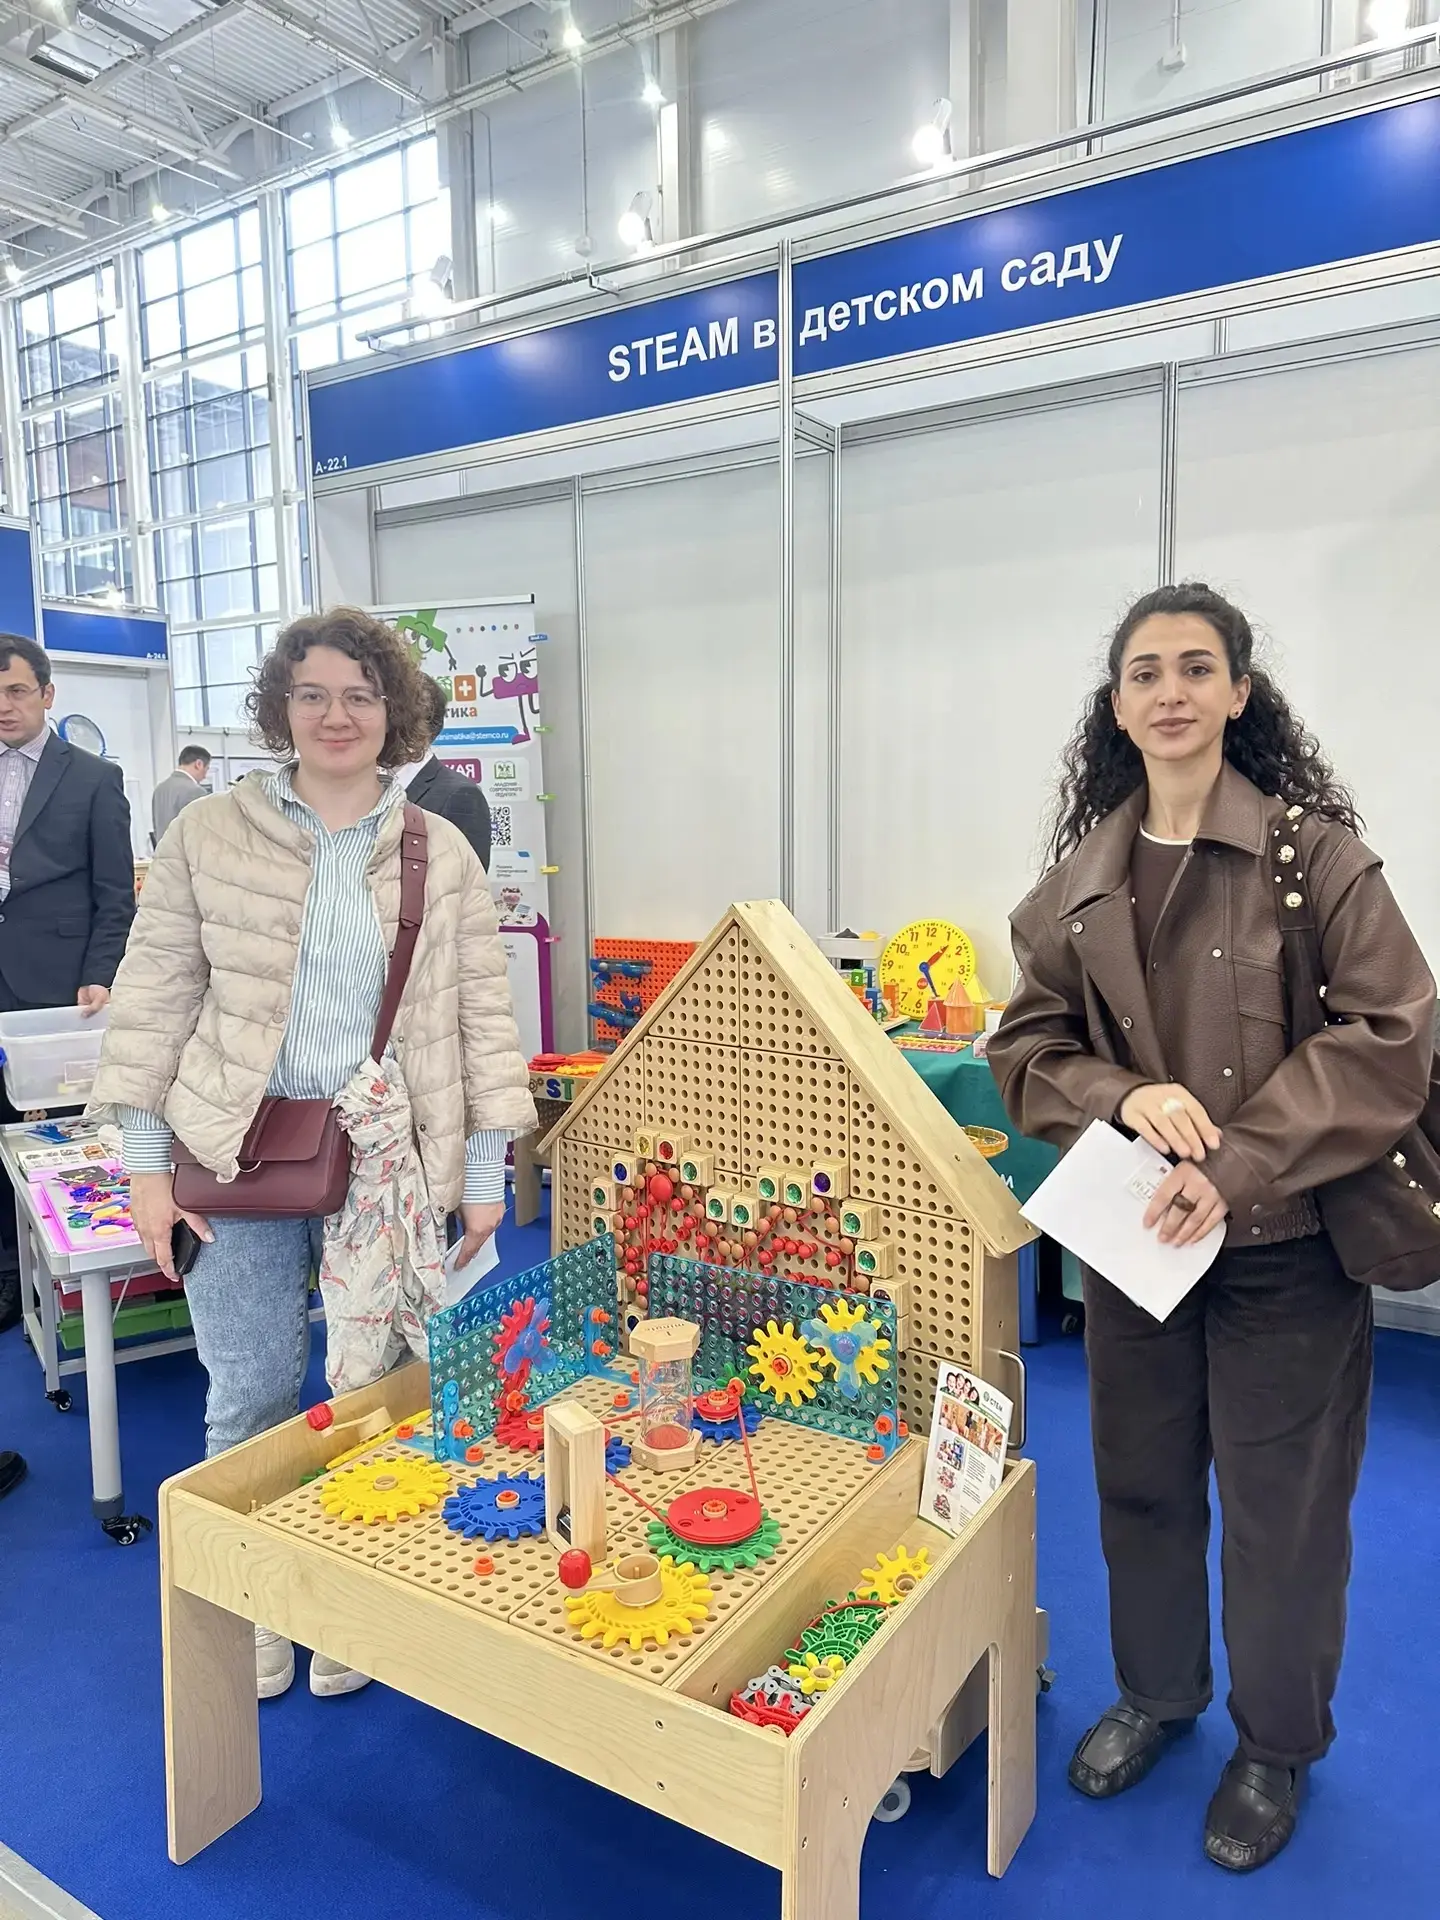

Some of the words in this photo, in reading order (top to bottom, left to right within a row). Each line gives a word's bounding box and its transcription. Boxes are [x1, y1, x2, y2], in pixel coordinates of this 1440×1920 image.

[607, 317, 739, 383] STEAM
[753, 319, 776, 350] в
[799, 267, 984, 347] детском
[1000, 234, 1124, 293] саду
[910, 932, 919, 942] 11
[926, 927, 937, 937] 12
[946, 931, 951, 941] 1
[896, 944, 907, 953] 10
[955, 945, 963, 955] 2
[887, 960, 894, 970] 9
[958, 965, 965, 975] 3
[901, 992, 908, 1001] 7
[915, 999, 922, 1009] 6
